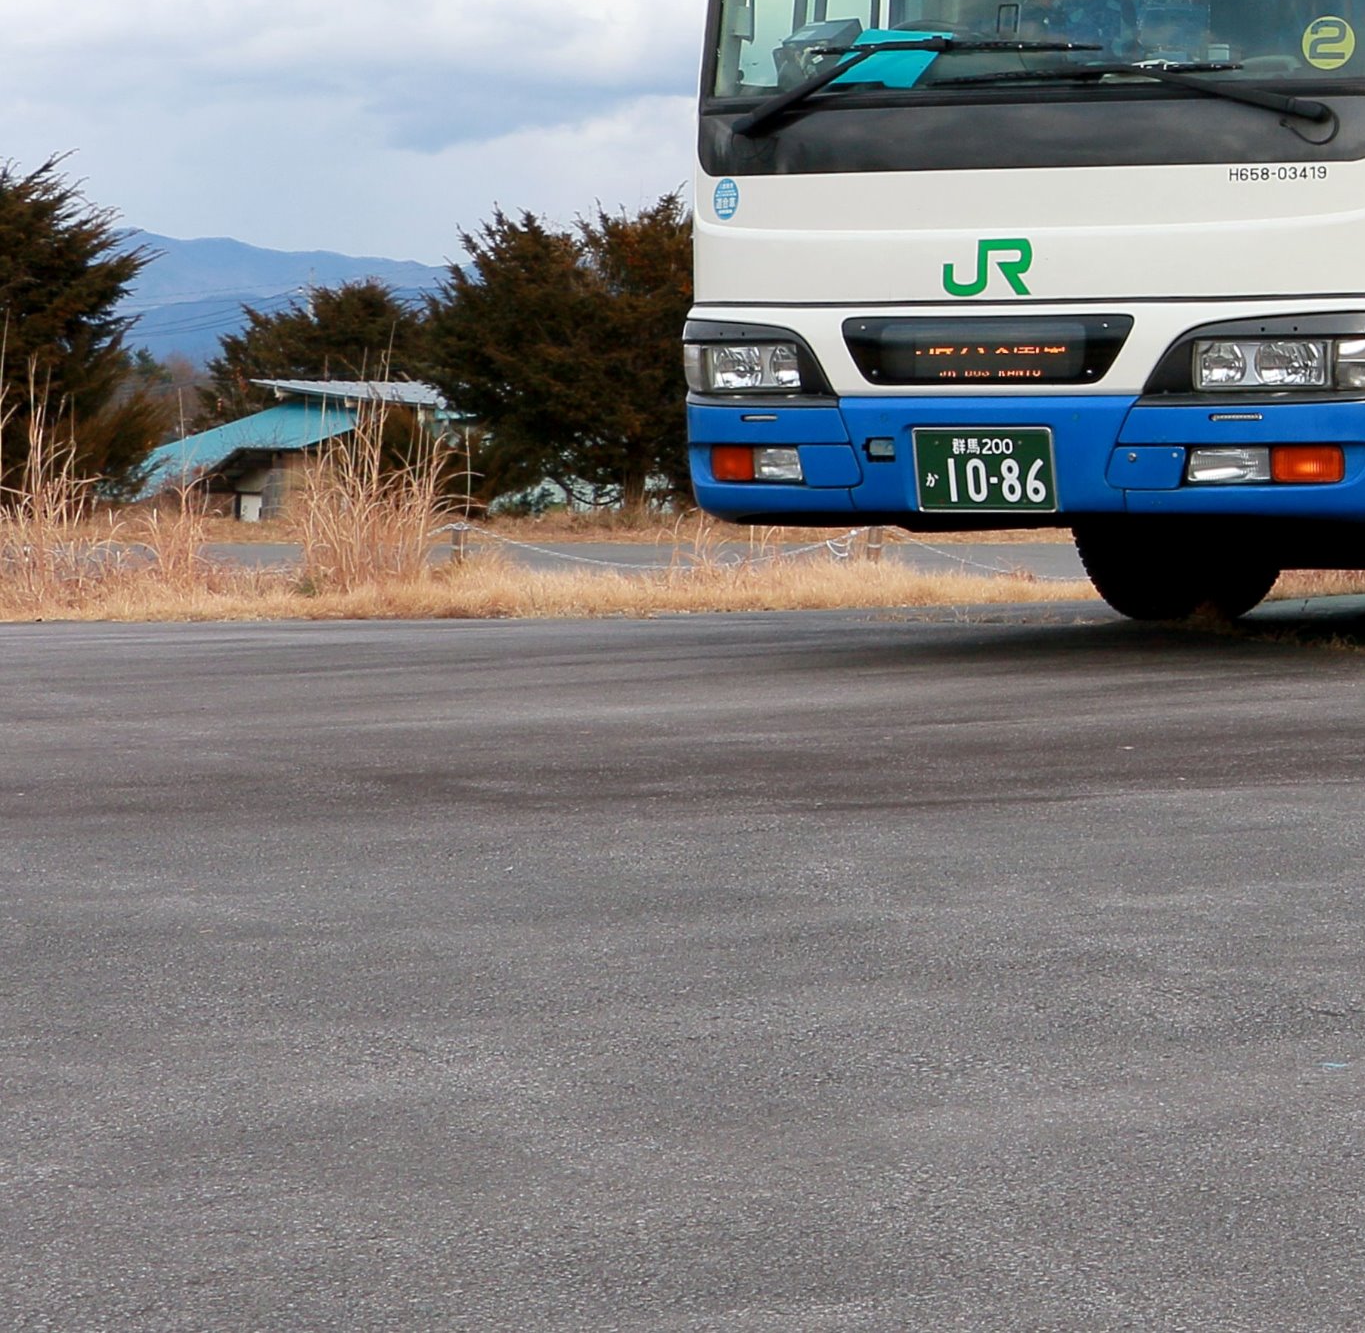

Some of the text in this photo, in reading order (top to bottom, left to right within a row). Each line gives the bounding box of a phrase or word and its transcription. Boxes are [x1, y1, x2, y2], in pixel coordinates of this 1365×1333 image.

[1309, 20, 1347, 59] 2
[1229, 166, 1327, 181] H658-03419
[943, 238, 1033, 297] JR
[926, 458, 1047, 503] か 10-86
